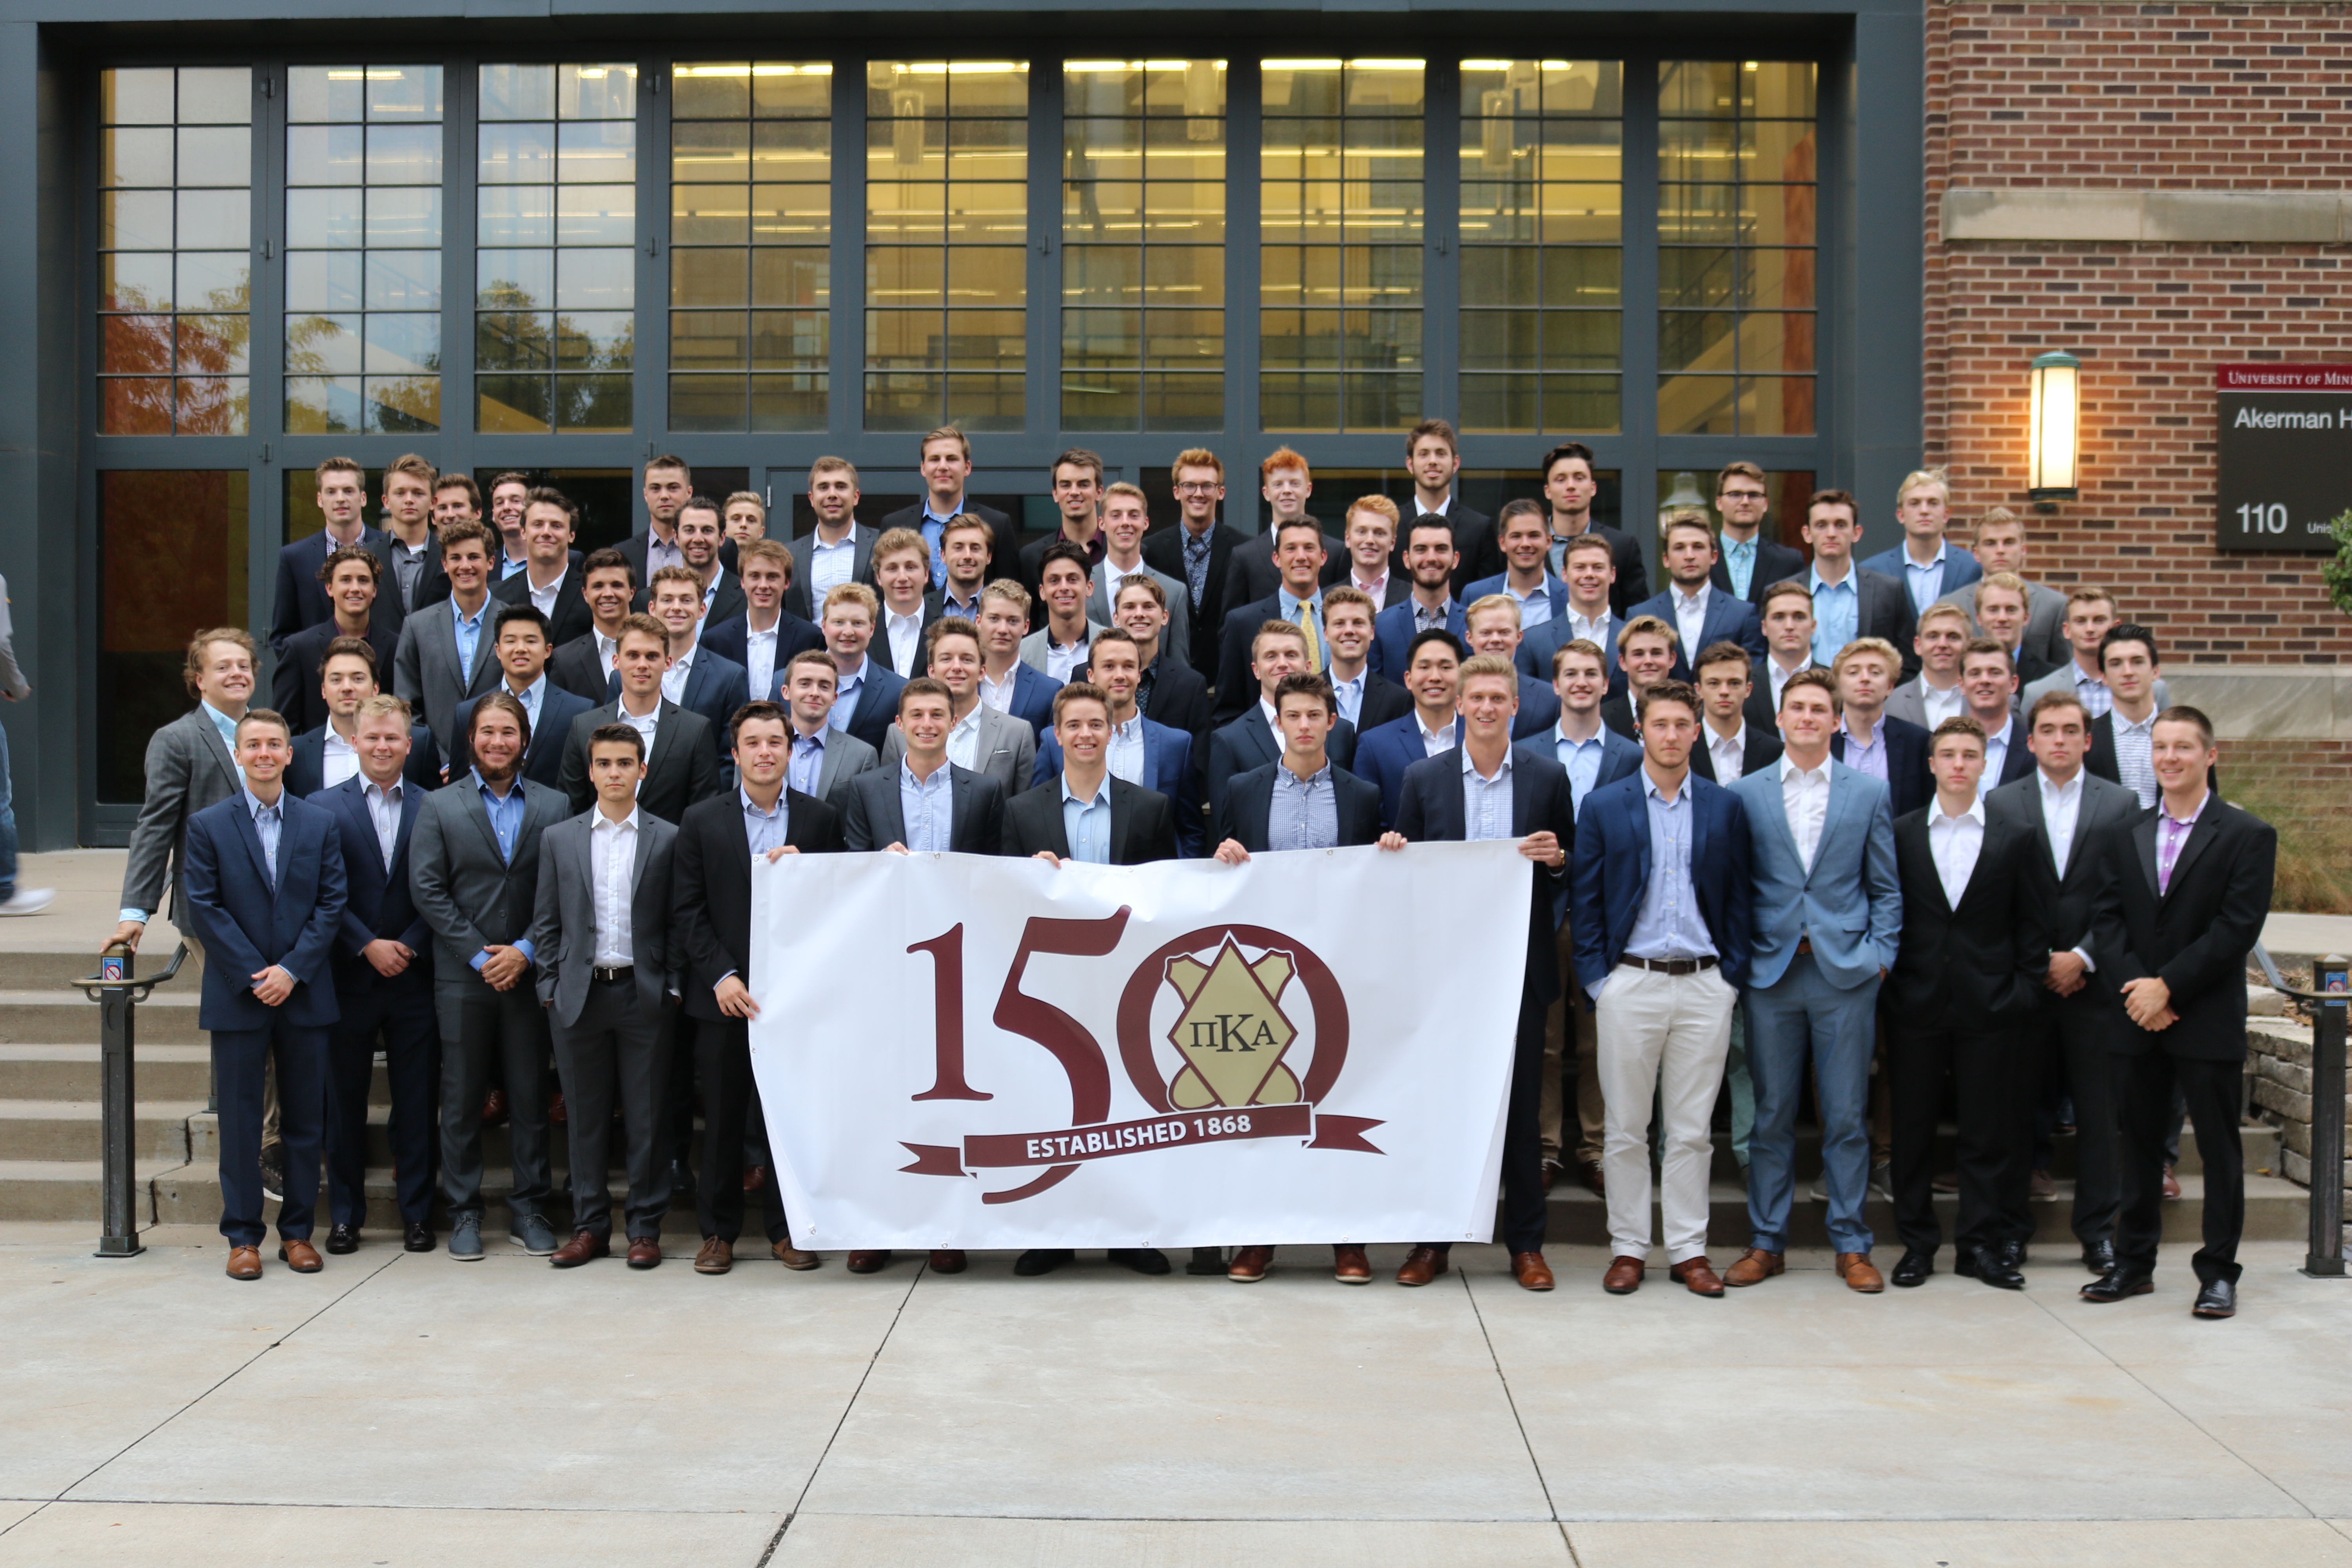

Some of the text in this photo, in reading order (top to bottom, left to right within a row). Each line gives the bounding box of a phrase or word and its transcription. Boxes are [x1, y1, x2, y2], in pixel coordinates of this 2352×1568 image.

[2228, 371, 2352, 385] UNIVERSITY OF MIN
[2234, 407, 2332, 429] Akerman
[2236, 503, 2288, 534] 110
[907, 905, 1350, 1205] 150
[1027, 1114, 1252, 1159] ESTABLISHED 1868
